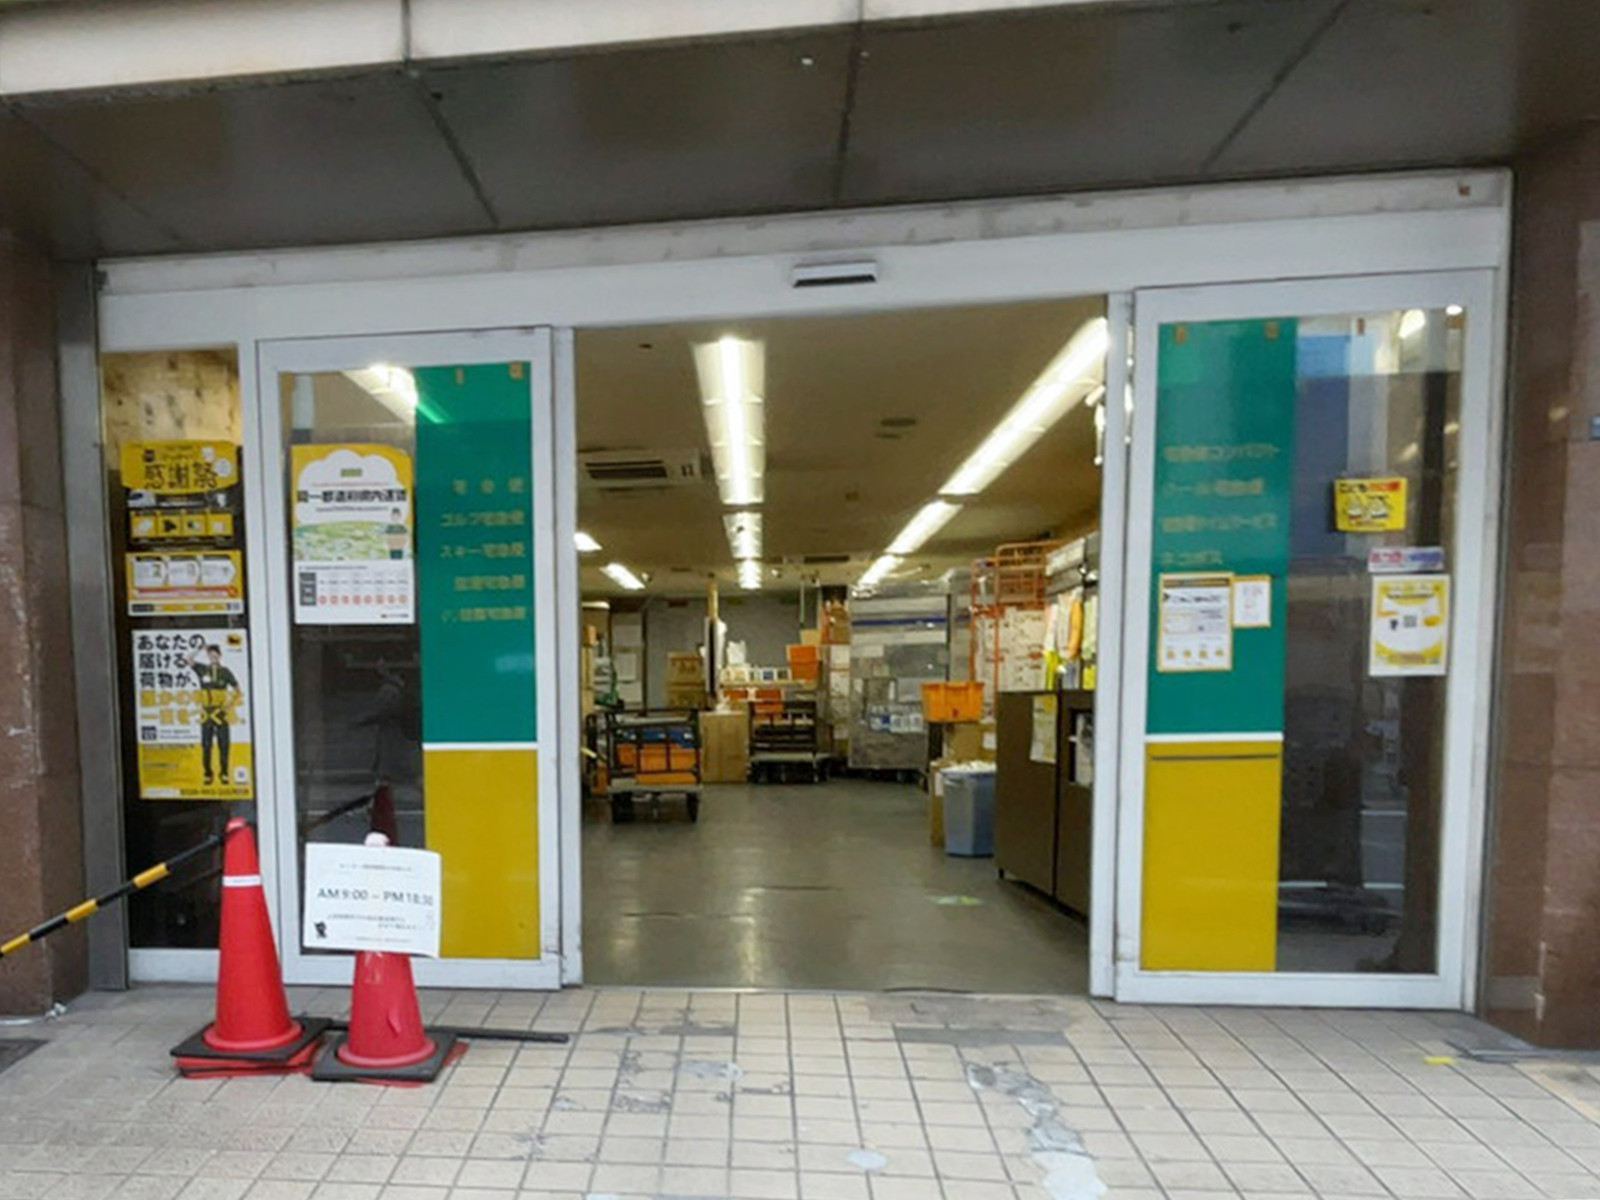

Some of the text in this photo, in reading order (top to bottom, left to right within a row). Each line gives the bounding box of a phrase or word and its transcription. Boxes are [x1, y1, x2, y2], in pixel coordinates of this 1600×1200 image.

[138, 634, 206, 650] あなたの
[139, 652, 188, 669] 届ける
